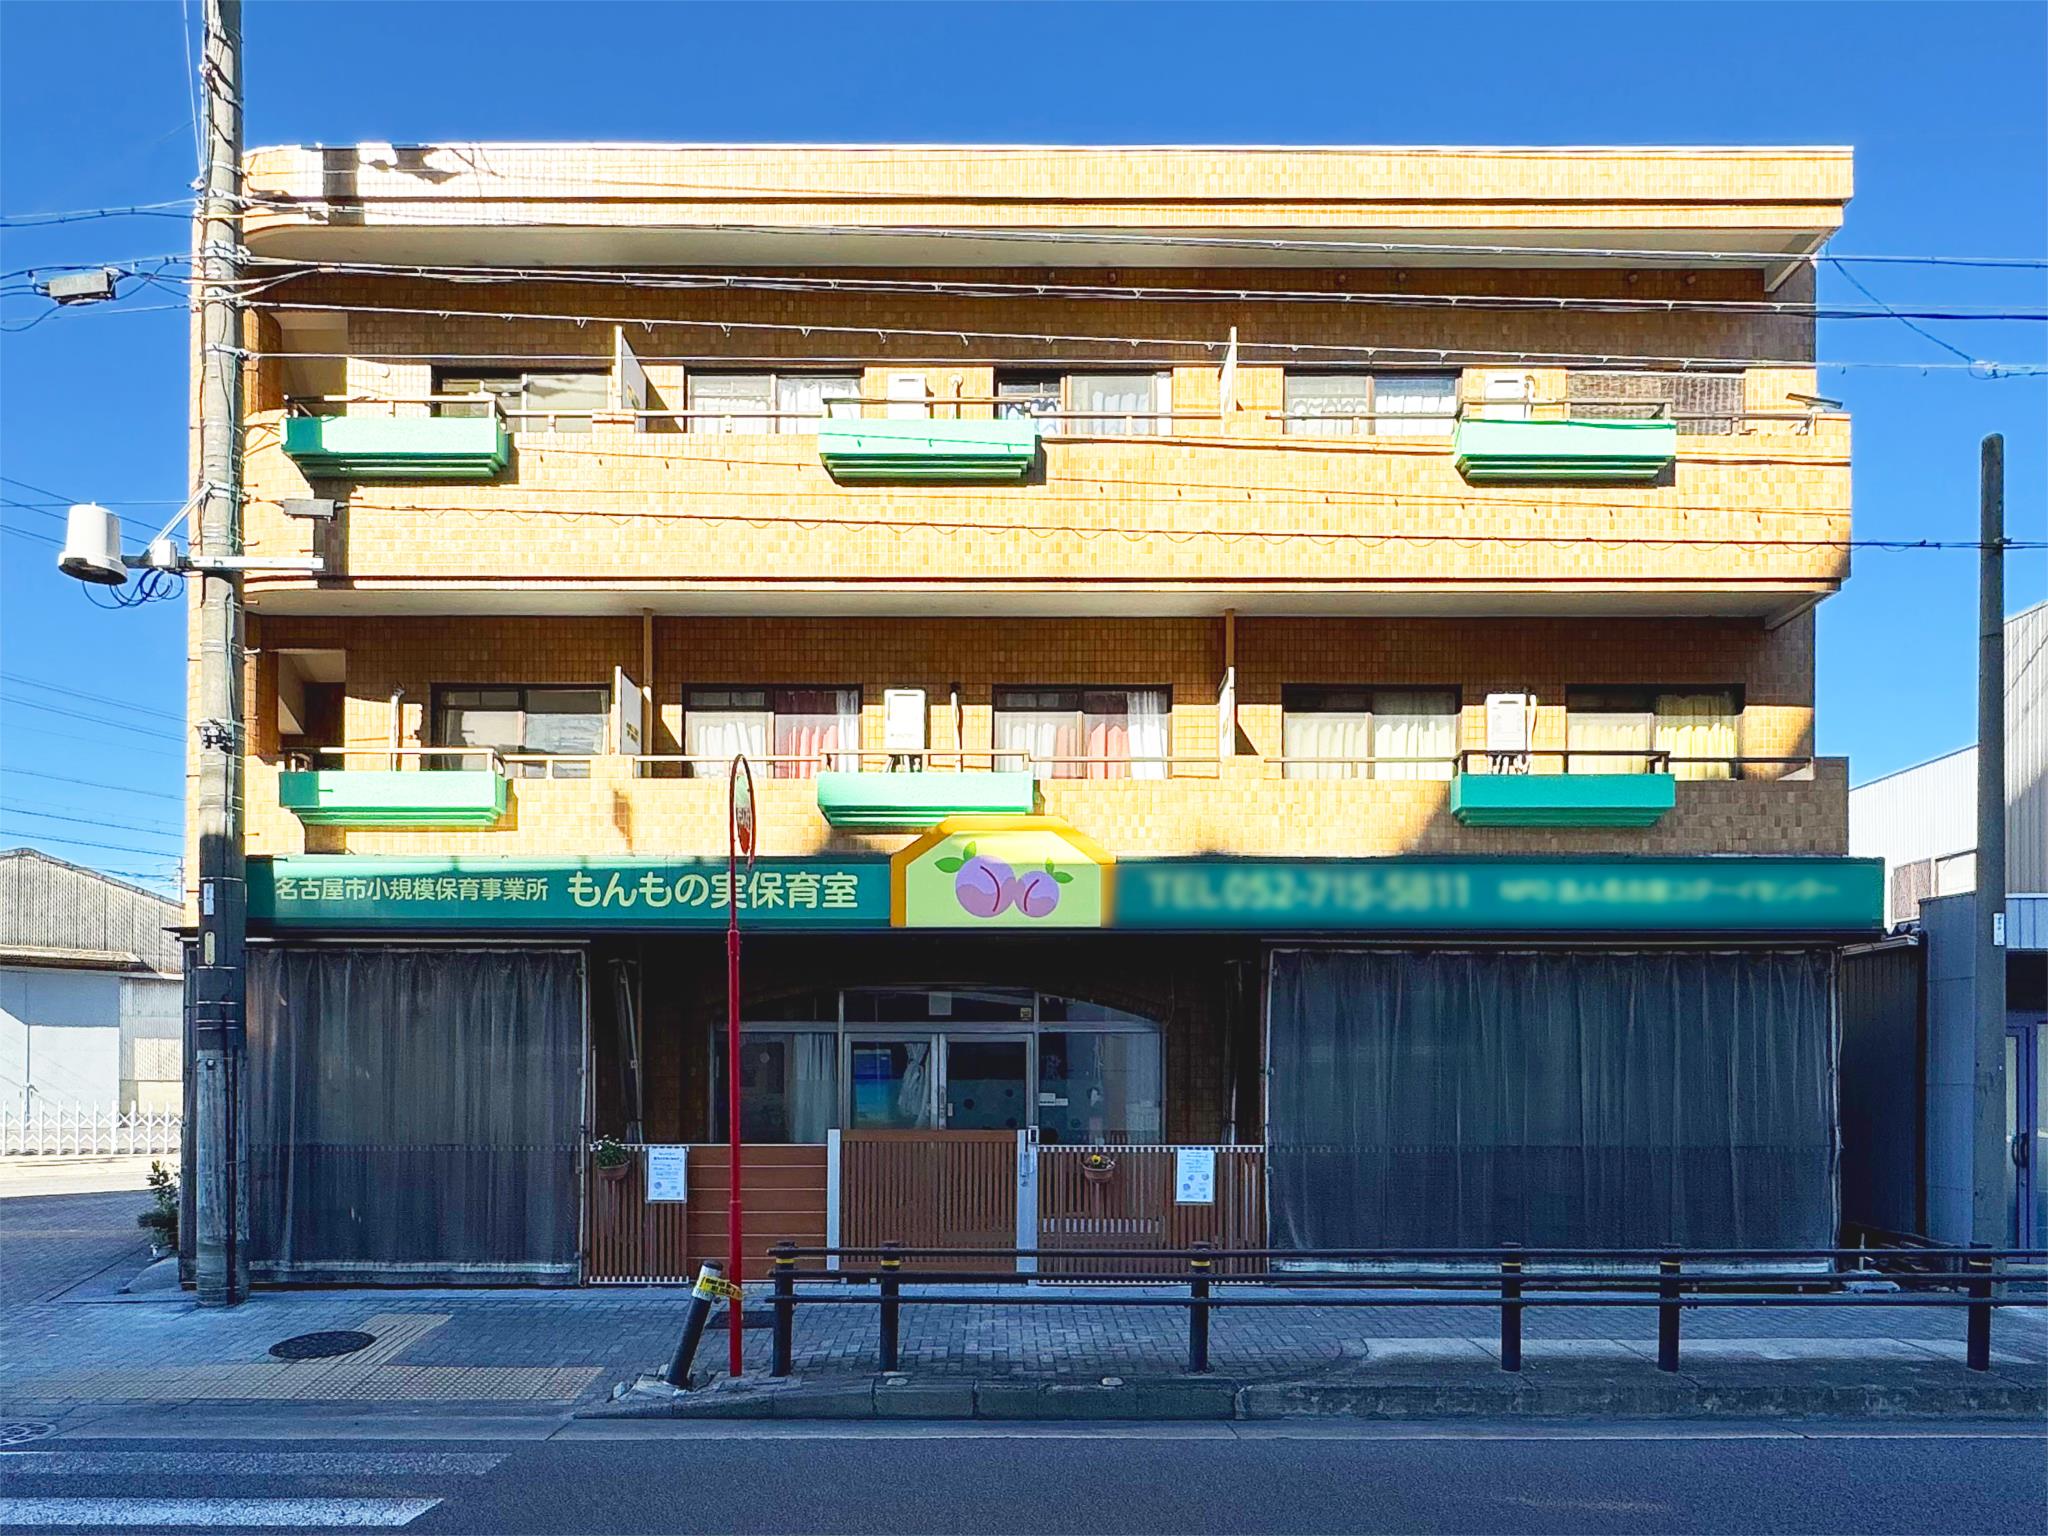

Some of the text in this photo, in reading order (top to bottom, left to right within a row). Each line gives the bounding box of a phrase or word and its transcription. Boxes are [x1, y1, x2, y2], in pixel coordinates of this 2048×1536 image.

[275, 871, 859, 909] 名古屋市小規模保育事業所 もんもの実保育室
